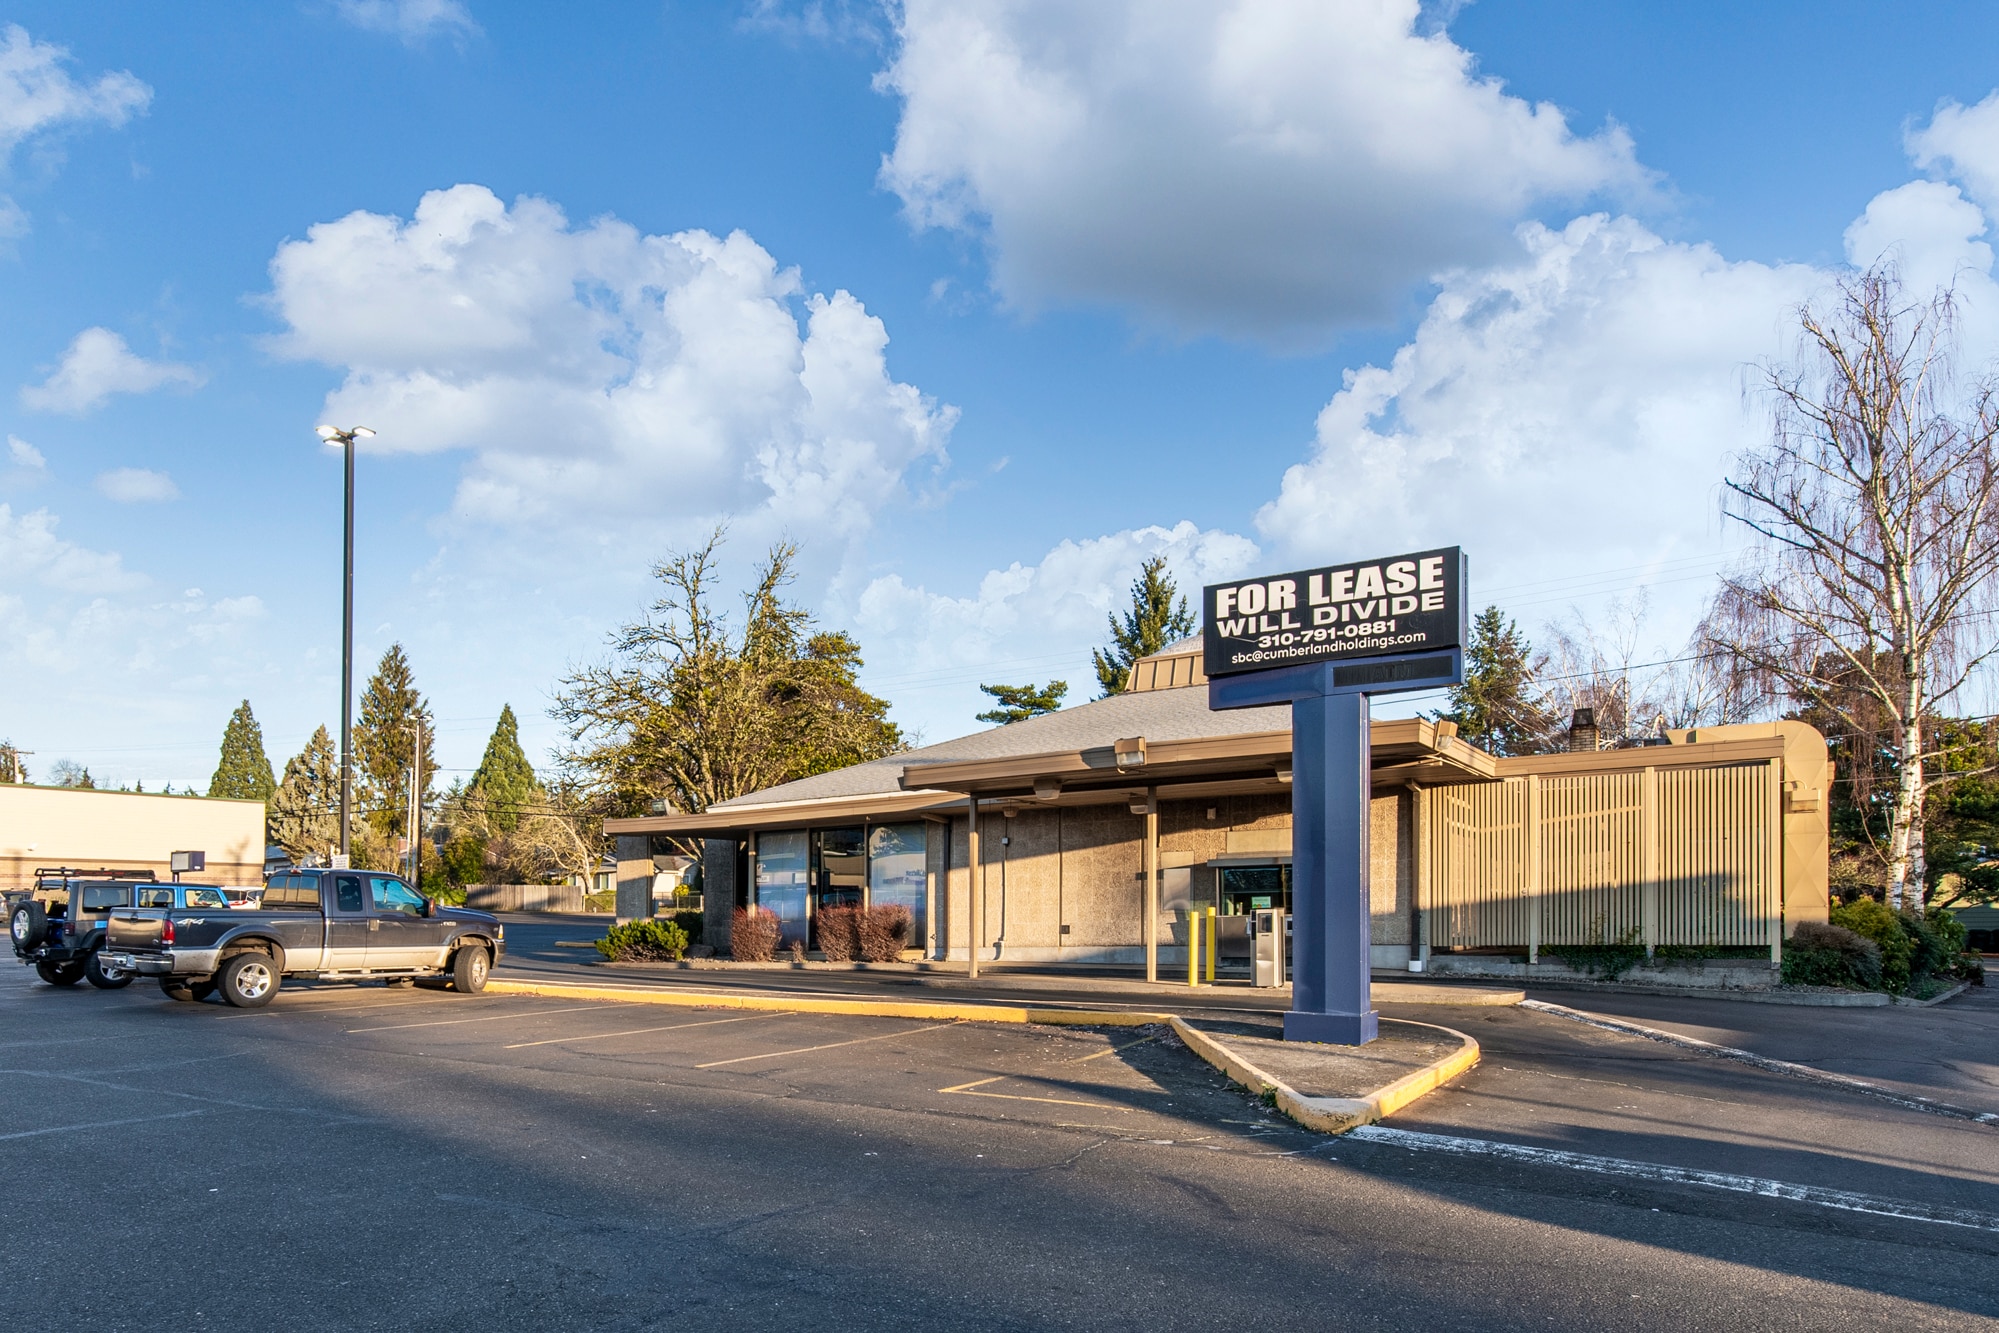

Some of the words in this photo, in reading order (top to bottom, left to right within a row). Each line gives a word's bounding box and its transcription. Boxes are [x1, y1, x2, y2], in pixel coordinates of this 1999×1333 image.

[1216, 579, 1297, 619] FOR
[1308, 556, 1444, 606] LEASE
[1216, 612, 1301, 638] WILL
[1313, 590, 1445, 626] DIVIDE
[1258, 619, 1396, 648] 310-791-0881
[1231, 632, 1426, 664] sbc@cumberlandholdings.com
